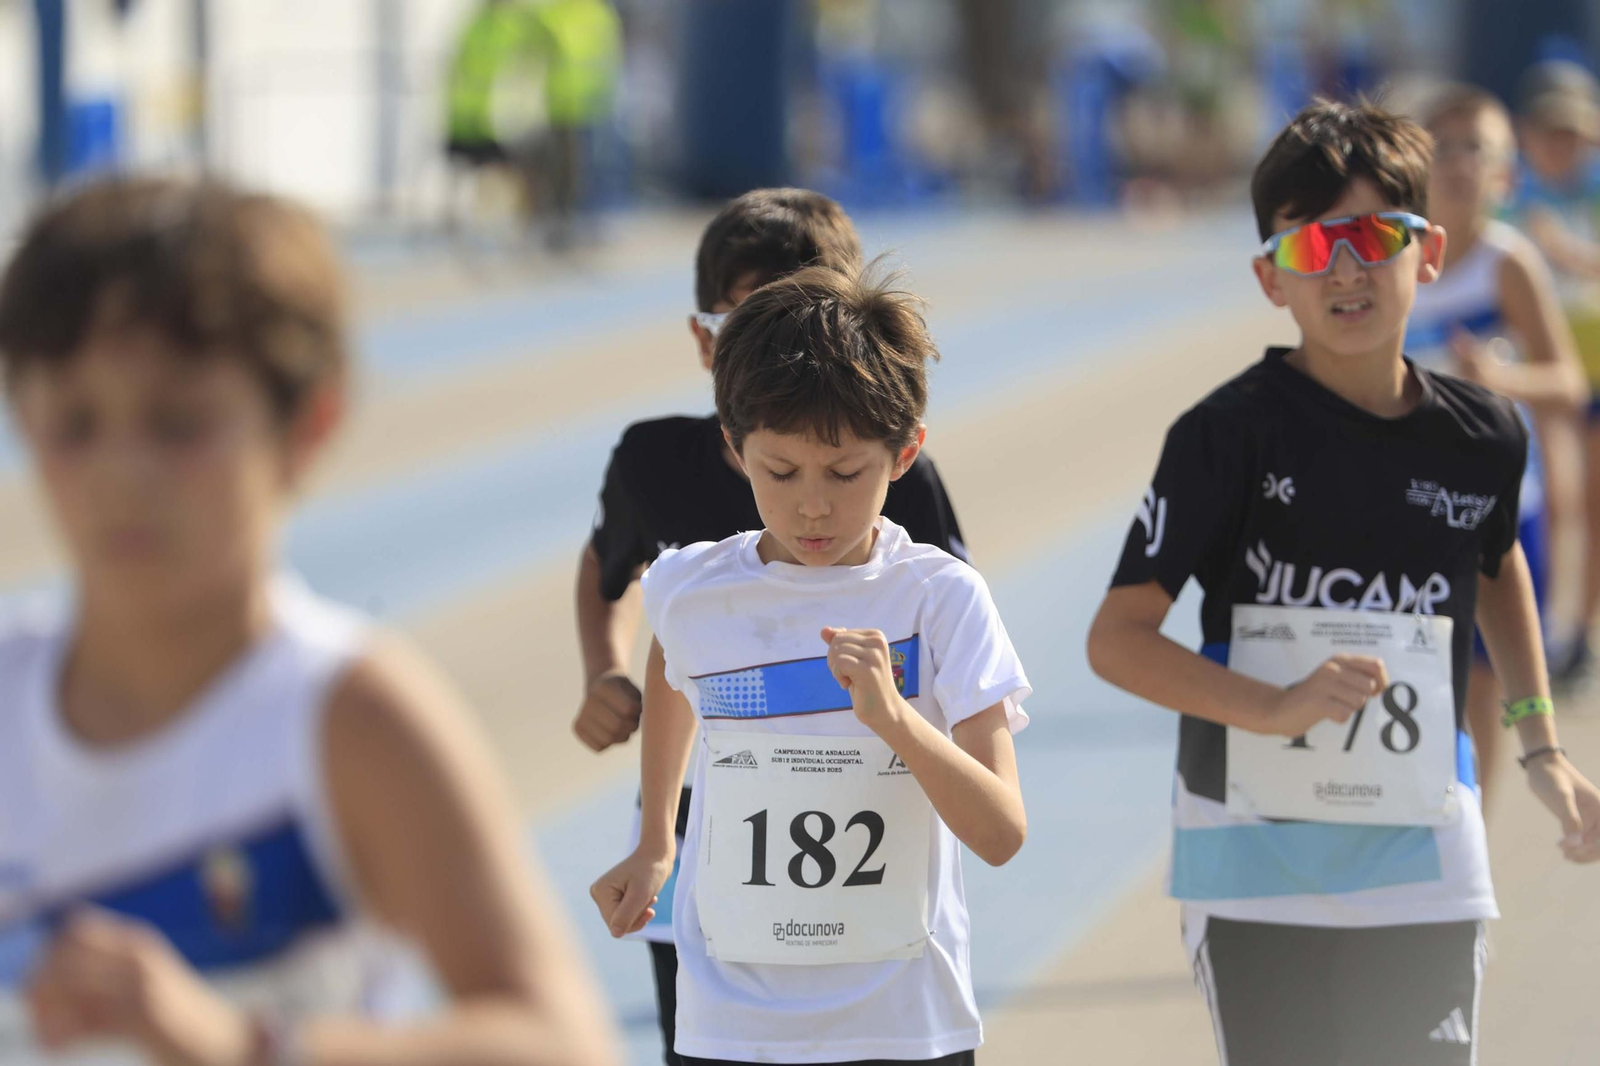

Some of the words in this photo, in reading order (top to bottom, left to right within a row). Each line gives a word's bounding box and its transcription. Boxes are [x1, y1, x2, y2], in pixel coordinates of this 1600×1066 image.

[1281, 681, 1421, 754] 78
[742, 809, 886, 888] 182
[785, 918, 845, 937] docunova
